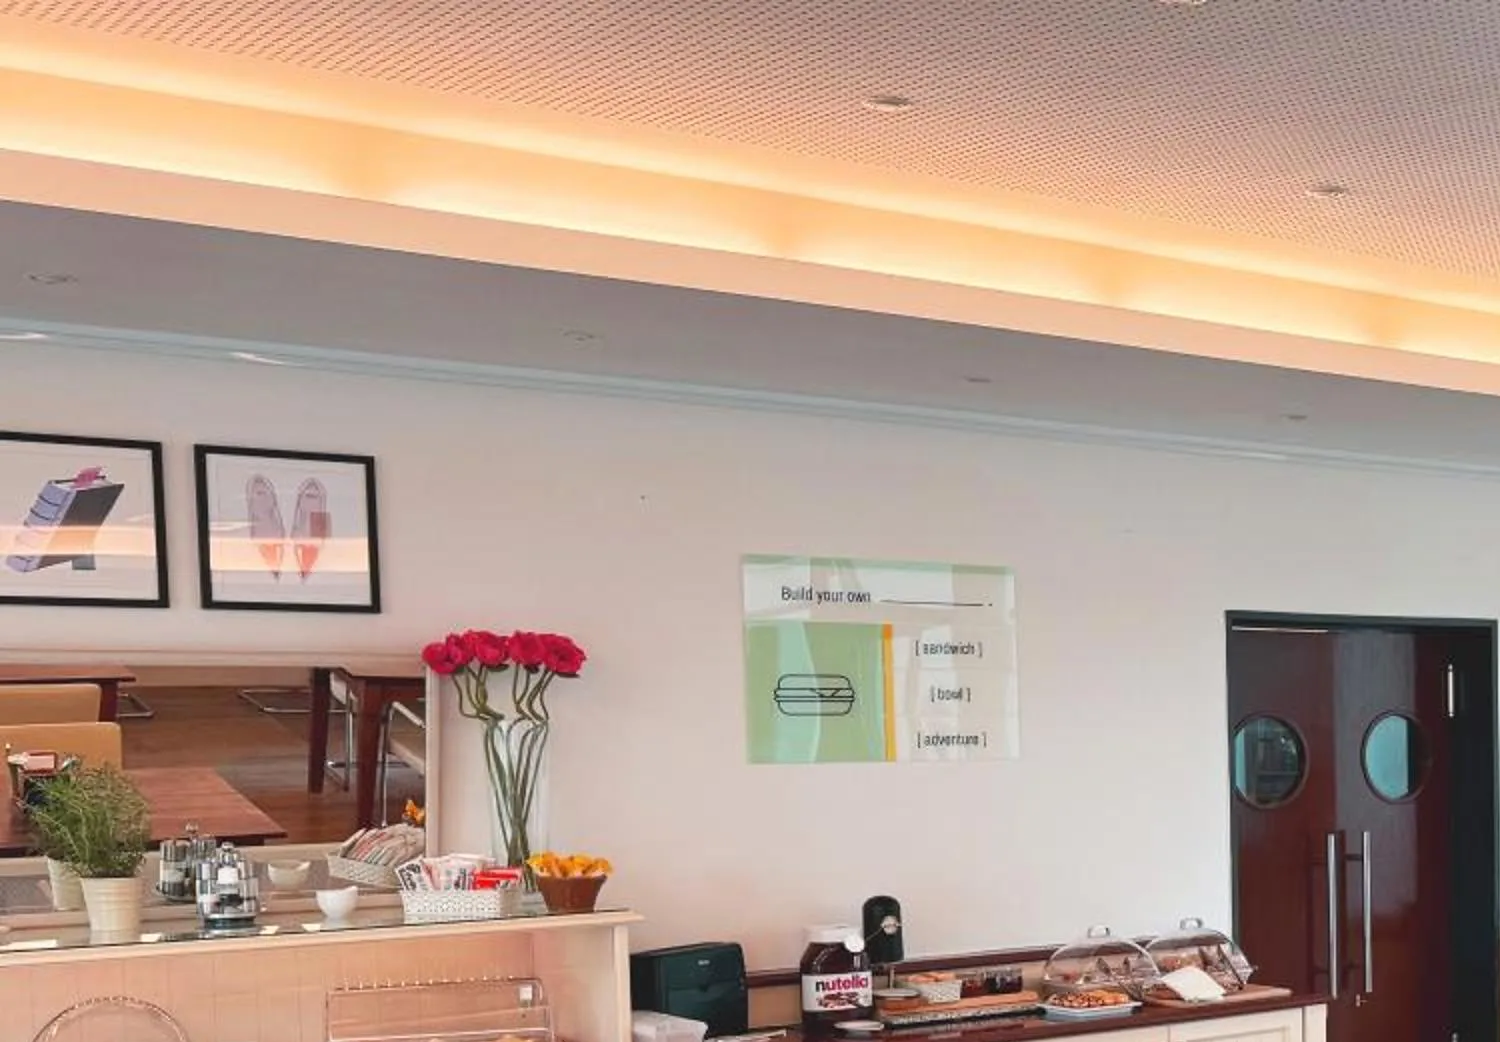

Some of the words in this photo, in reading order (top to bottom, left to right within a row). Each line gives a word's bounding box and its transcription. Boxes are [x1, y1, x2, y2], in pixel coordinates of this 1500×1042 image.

[815, 591, 844, 605] your
[847, 591, 871, 602] own
[923, 642, 975, 655] sandwich
[923, 733, 980, 746] adventure
[815, 975, 869, 993] nutella
